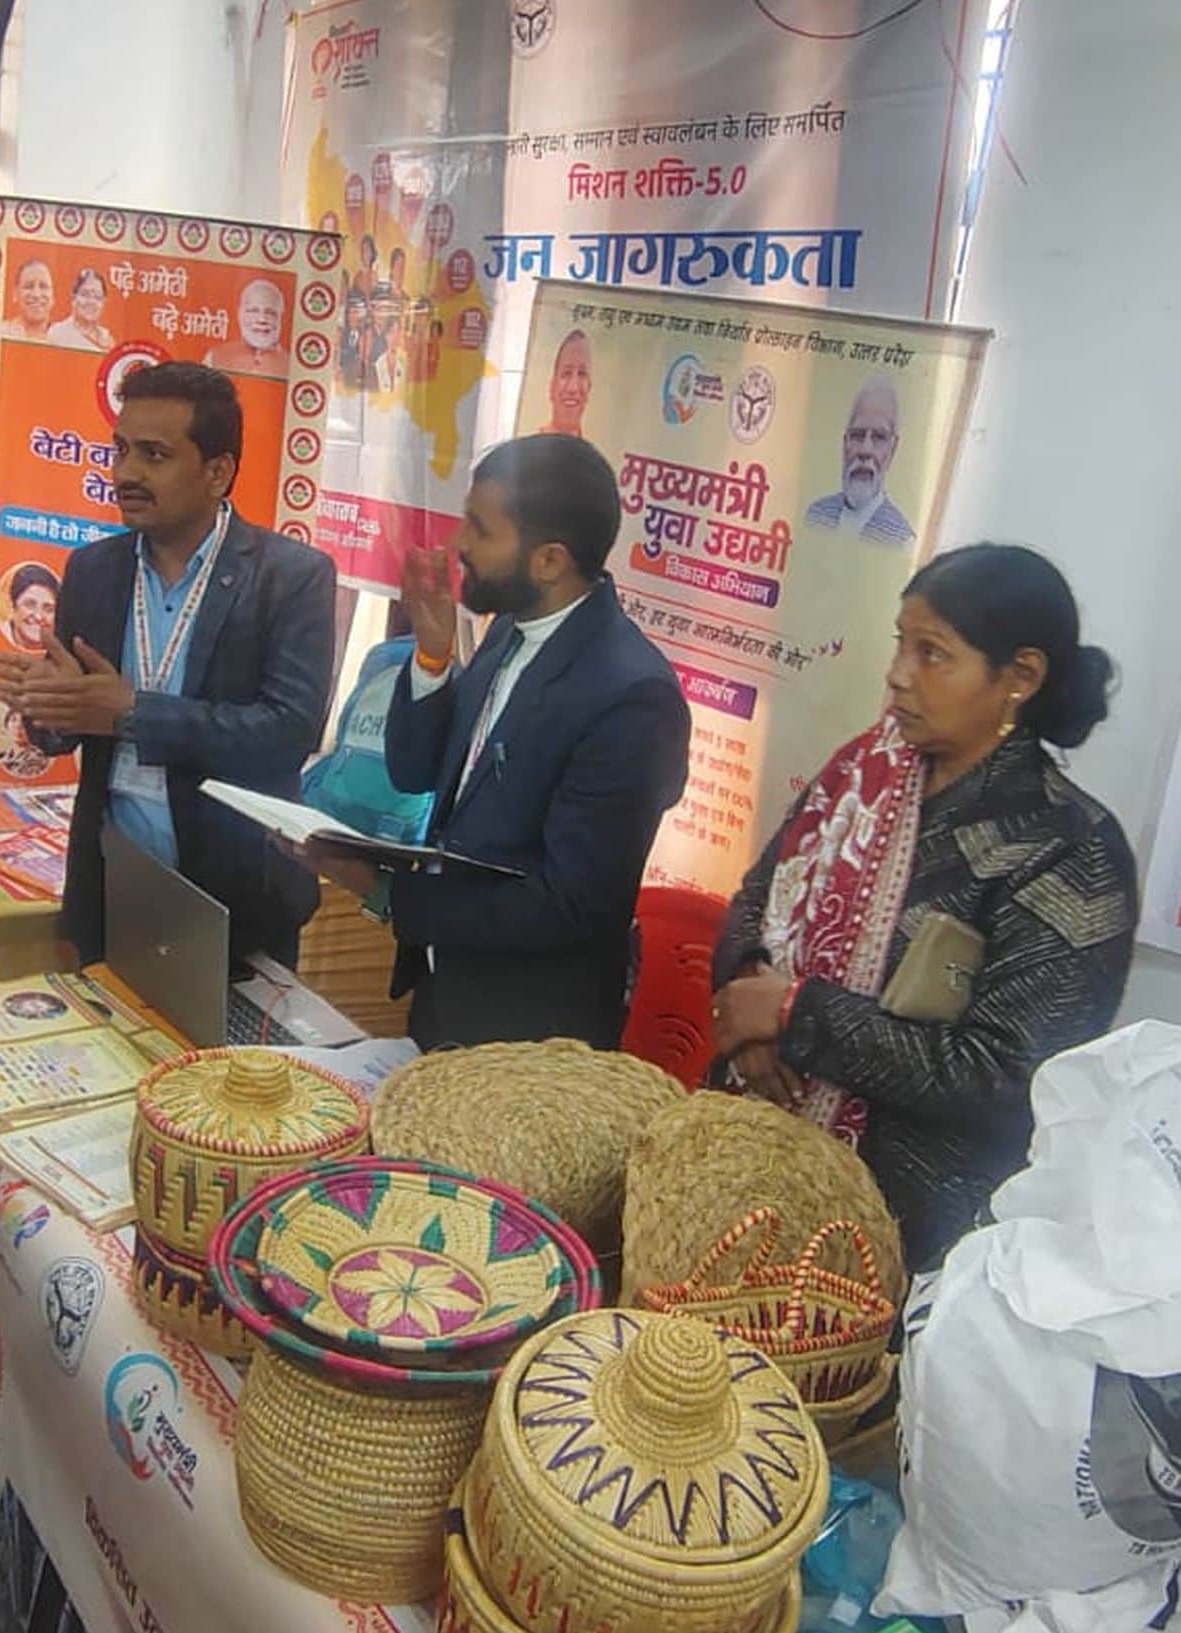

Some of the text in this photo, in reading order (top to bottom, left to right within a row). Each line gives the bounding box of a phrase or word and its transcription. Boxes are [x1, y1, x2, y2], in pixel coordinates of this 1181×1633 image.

[642, 116, 718, 146] स्वावलंबन
[722, 114, 740, 140] के
[744, 111, 782, 139] लिए
[784, 101, 847, 137] समर्पित
[568, 163, 628, 201] मिशन
[483, 234, 556, 283] जन
[138, 265, 188, 298] अमेठी
[180, 306, 229, 341] अमेठी
[31, 427, 84, 465] बेटी
[620, 452, 770, 523] मुख्यमंत्री
[643, 503, 793, 573] युवा उद्यमी
[665, 555, 773, 604] विकास अभियान
